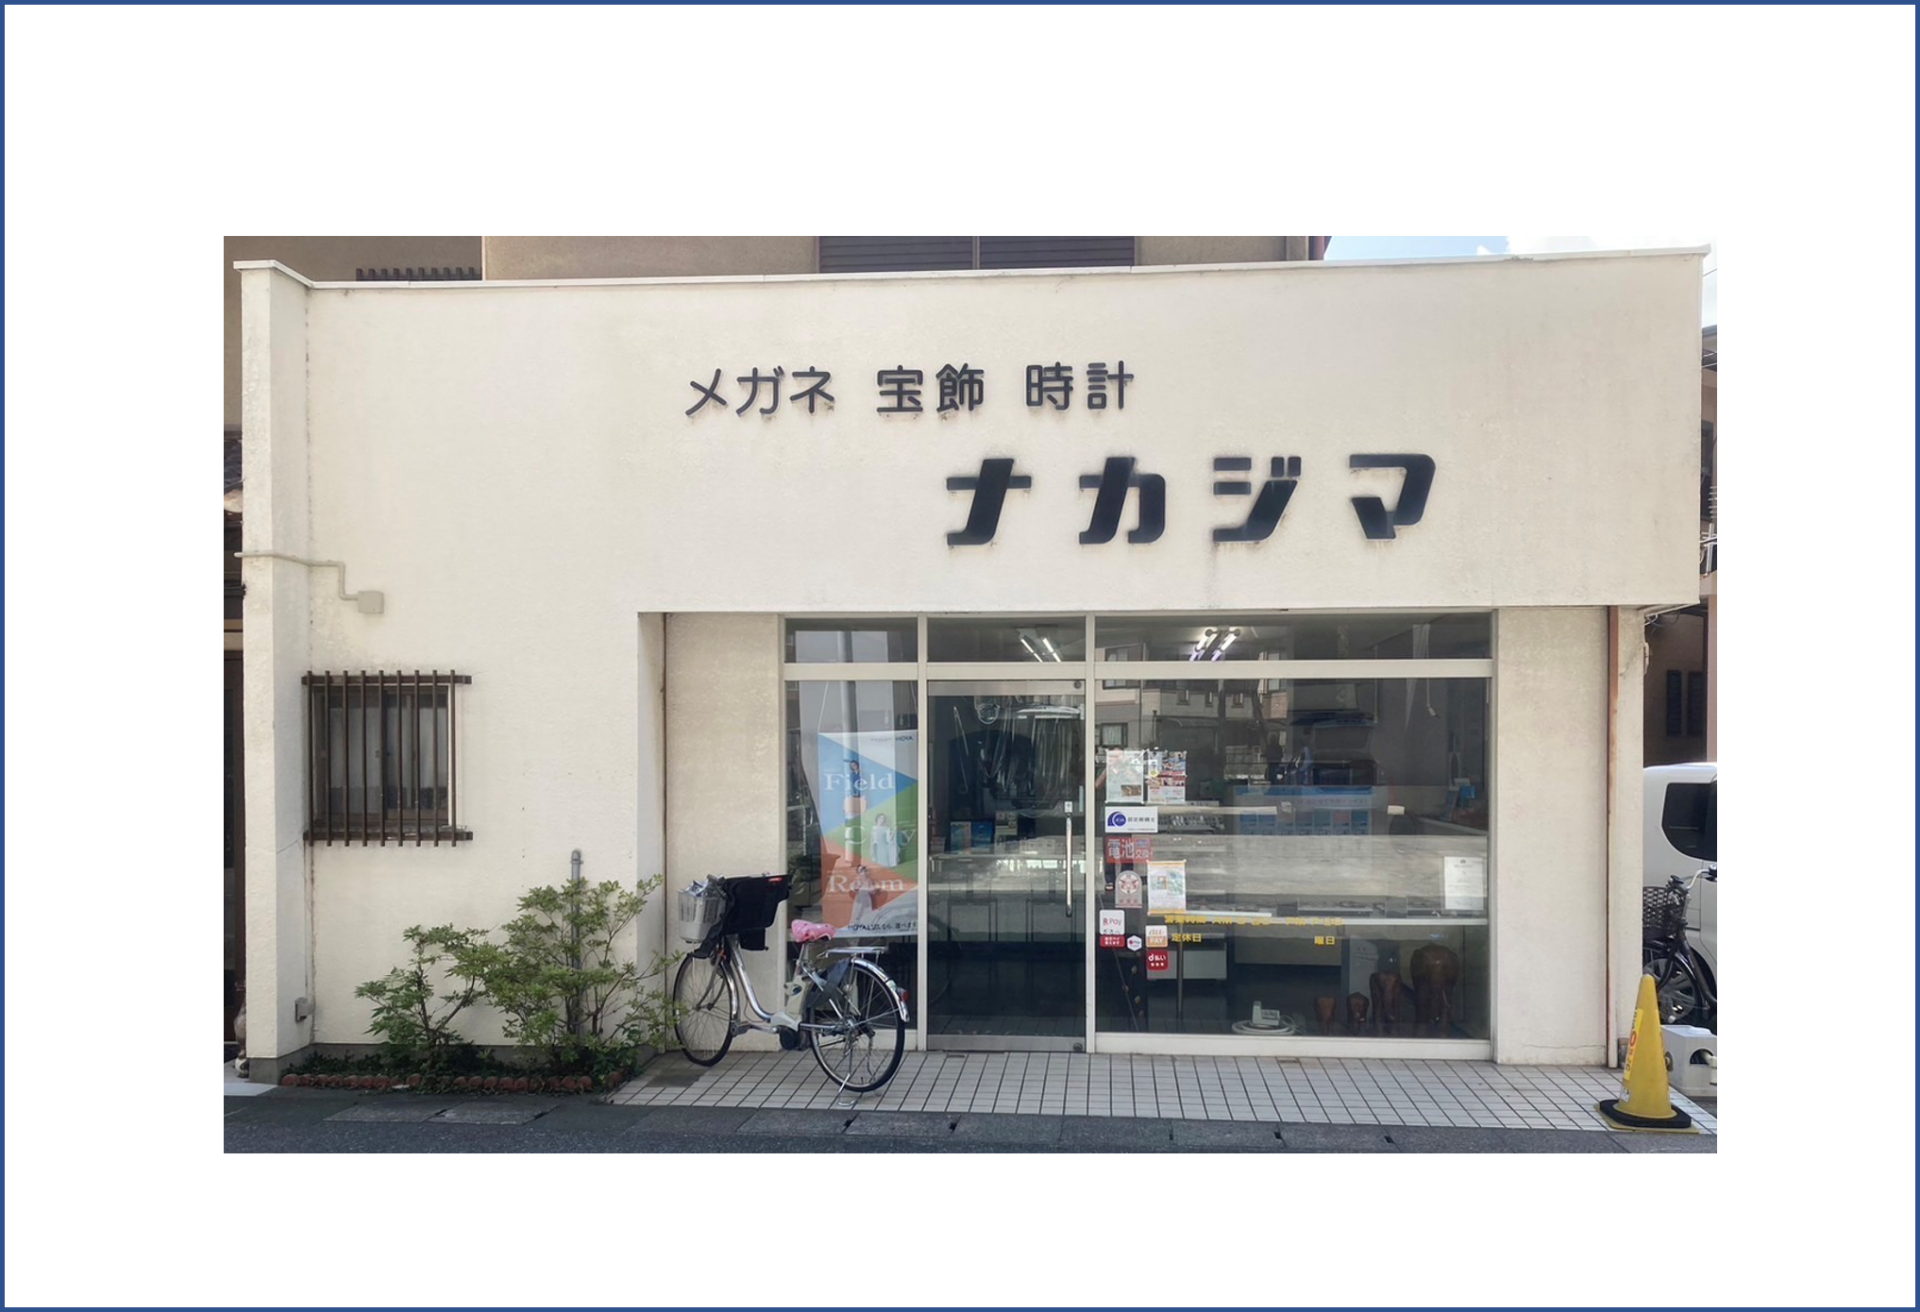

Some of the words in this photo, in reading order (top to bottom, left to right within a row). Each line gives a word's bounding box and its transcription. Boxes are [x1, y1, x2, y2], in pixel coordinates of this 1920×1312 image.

[686, 364, 834, 415] メガネ
[876, 363, 984, 412] 宝飾
[1026, 361, 1134, 410] 時計
[947, 454, 1436, 545] ナカジマ
[824, 773, 894, 791] Field
[1172, 933, 1202, 943] 定休日
